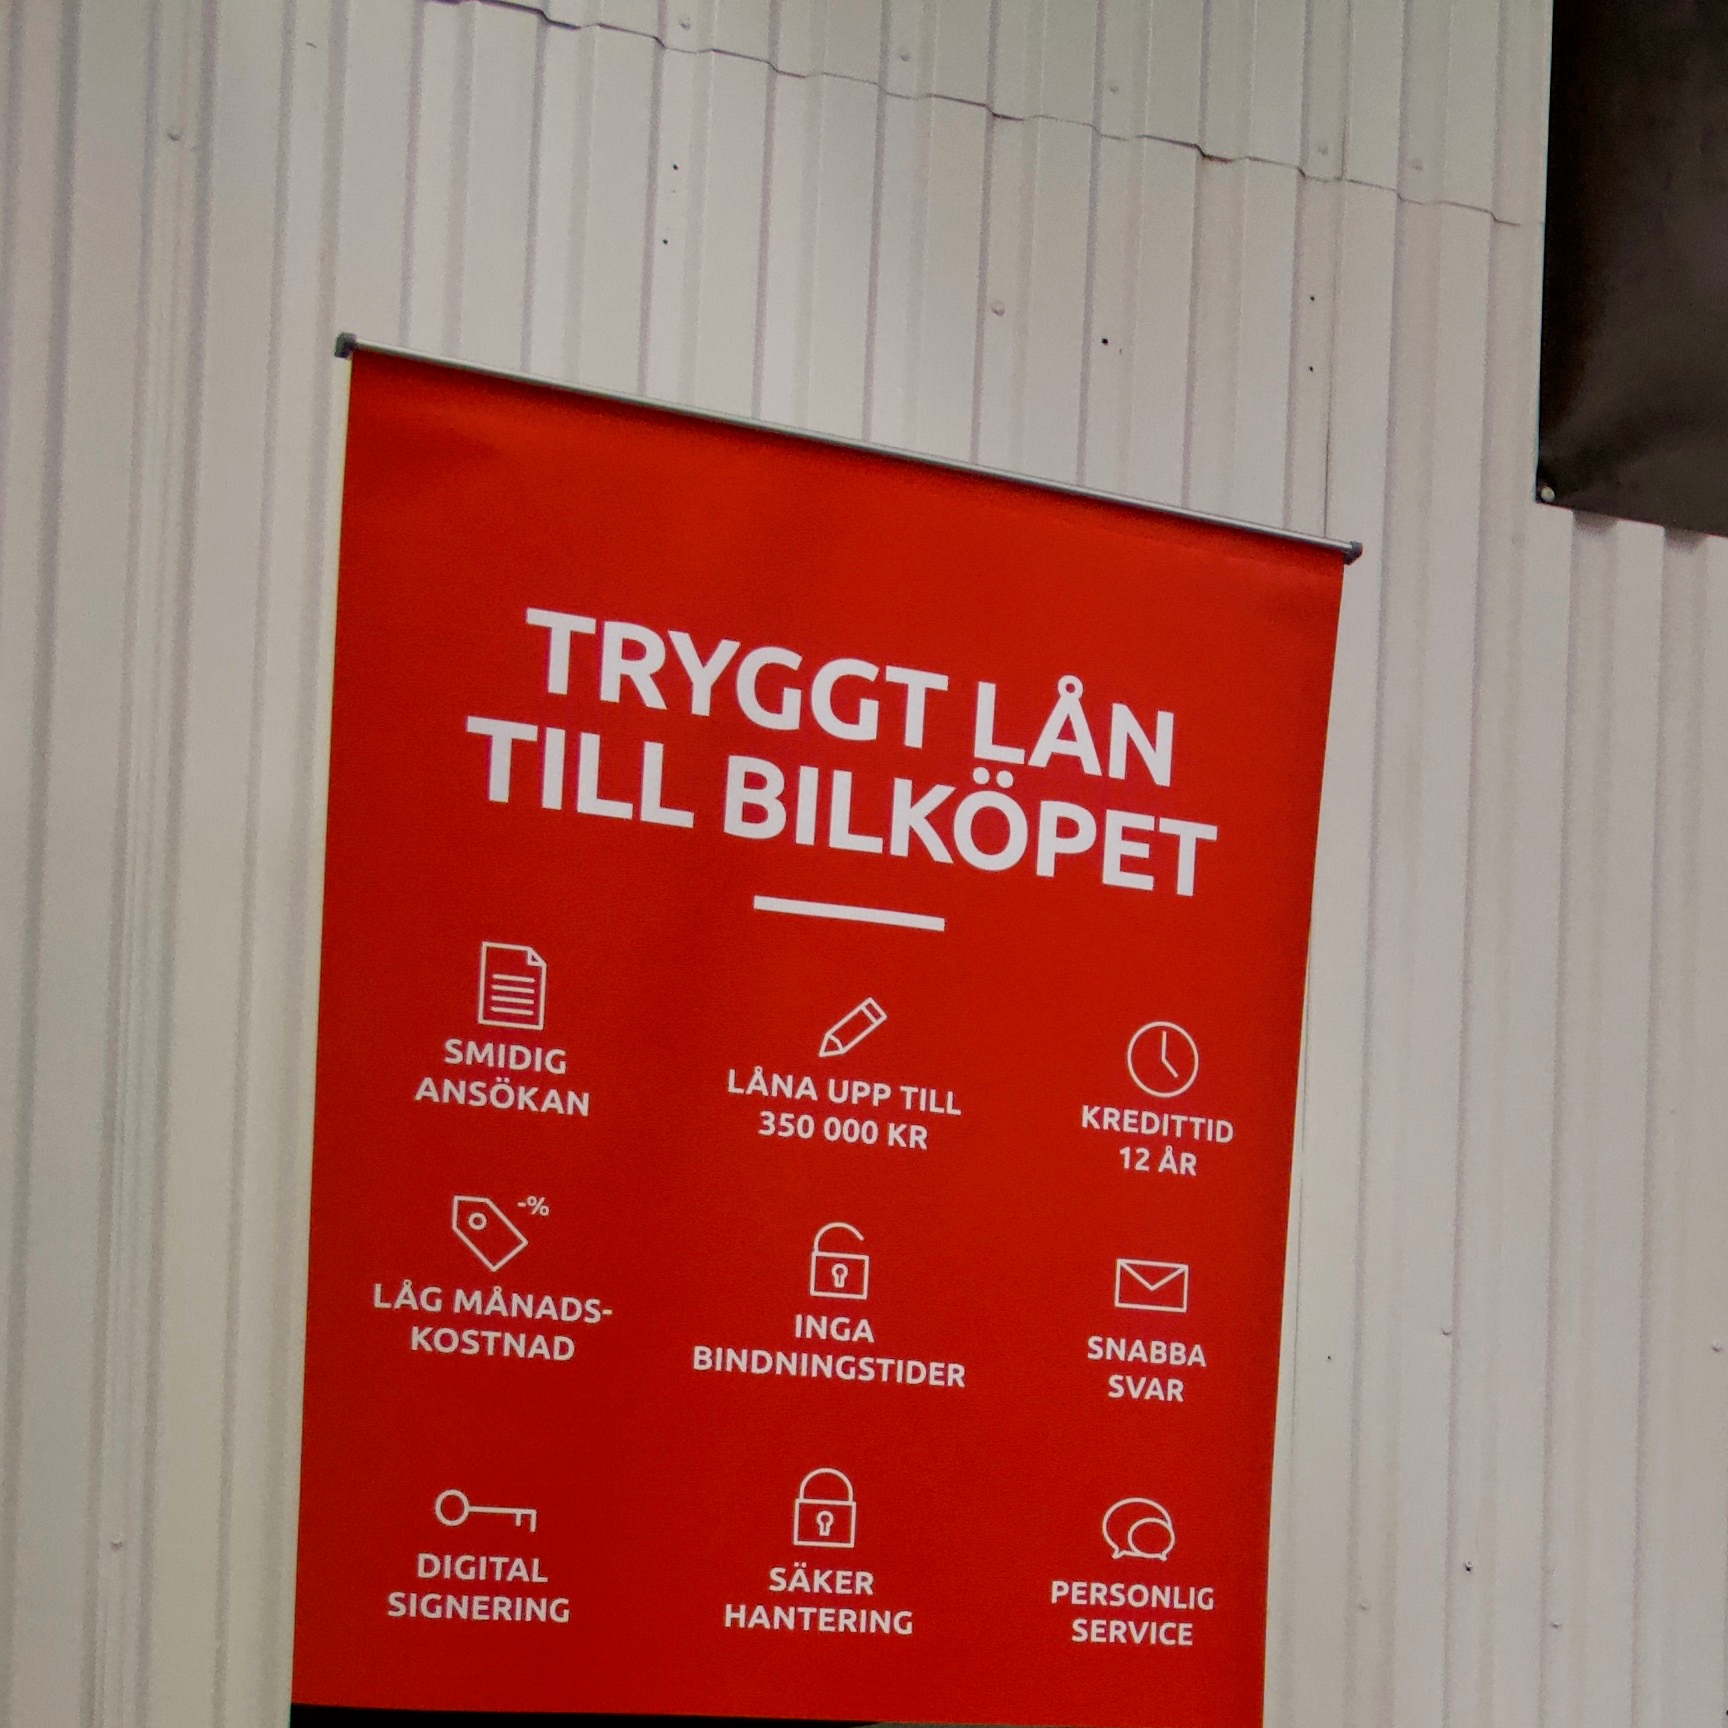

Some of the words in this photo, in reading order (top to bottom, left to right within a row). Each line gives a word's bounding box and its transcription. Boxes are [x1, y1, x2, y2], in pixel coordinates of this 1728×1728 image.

[526, 608, 948, 750] TRYGGT
[973, 675, 1174, 788] LÅN
[467, 716, 694, 828] TILL
[724, 755, 1217, 896] BILKÖPET
[445, 1039, 566, 1074] SMIDIG
[415, 1077, 589, 1116] ANSÖKAN
[728, 1066, 818, 1100] LÅNA
[828, 1079, 891, 1106] UPP
[900, 1086, 961, 1115] TILL
[759, 1111, 814, 1138] 350
[824, 1117, 878, 1144] 000
[888, 1123, 927, 1149] KR
[1082, 1105, 1233, 1143] KREDITTID
[1120, 1147, 1149, 1171] 12
[1158, 1145, 1196, 1176] ÅR
[374, 1279, 442, 1312] LÅG
[454, 1286, 612, 1323] MÅNADS-
[412, 1327, 574, 1360] KOSTNAD
[796, 1314, 874, 1343] INGA
[694, 1346, 965, 1387] BINDNINGSTIDER
[1088, 1336, 1206, 1367] SNABBA
[1108, 1375, 1183, 1402] SVAR
[418, 1553, 548, 1582] DIGITAL
[770, 1562, 873, 1595] SÄKER
[388, 1592, 569, 1623] SIGNERING
[1052, 1581, 1213, 1610] PERSONLIG
[725, 1604, 912, 1634] HANTERING
[1072, 1619, 1192, 1645] SERVICE
